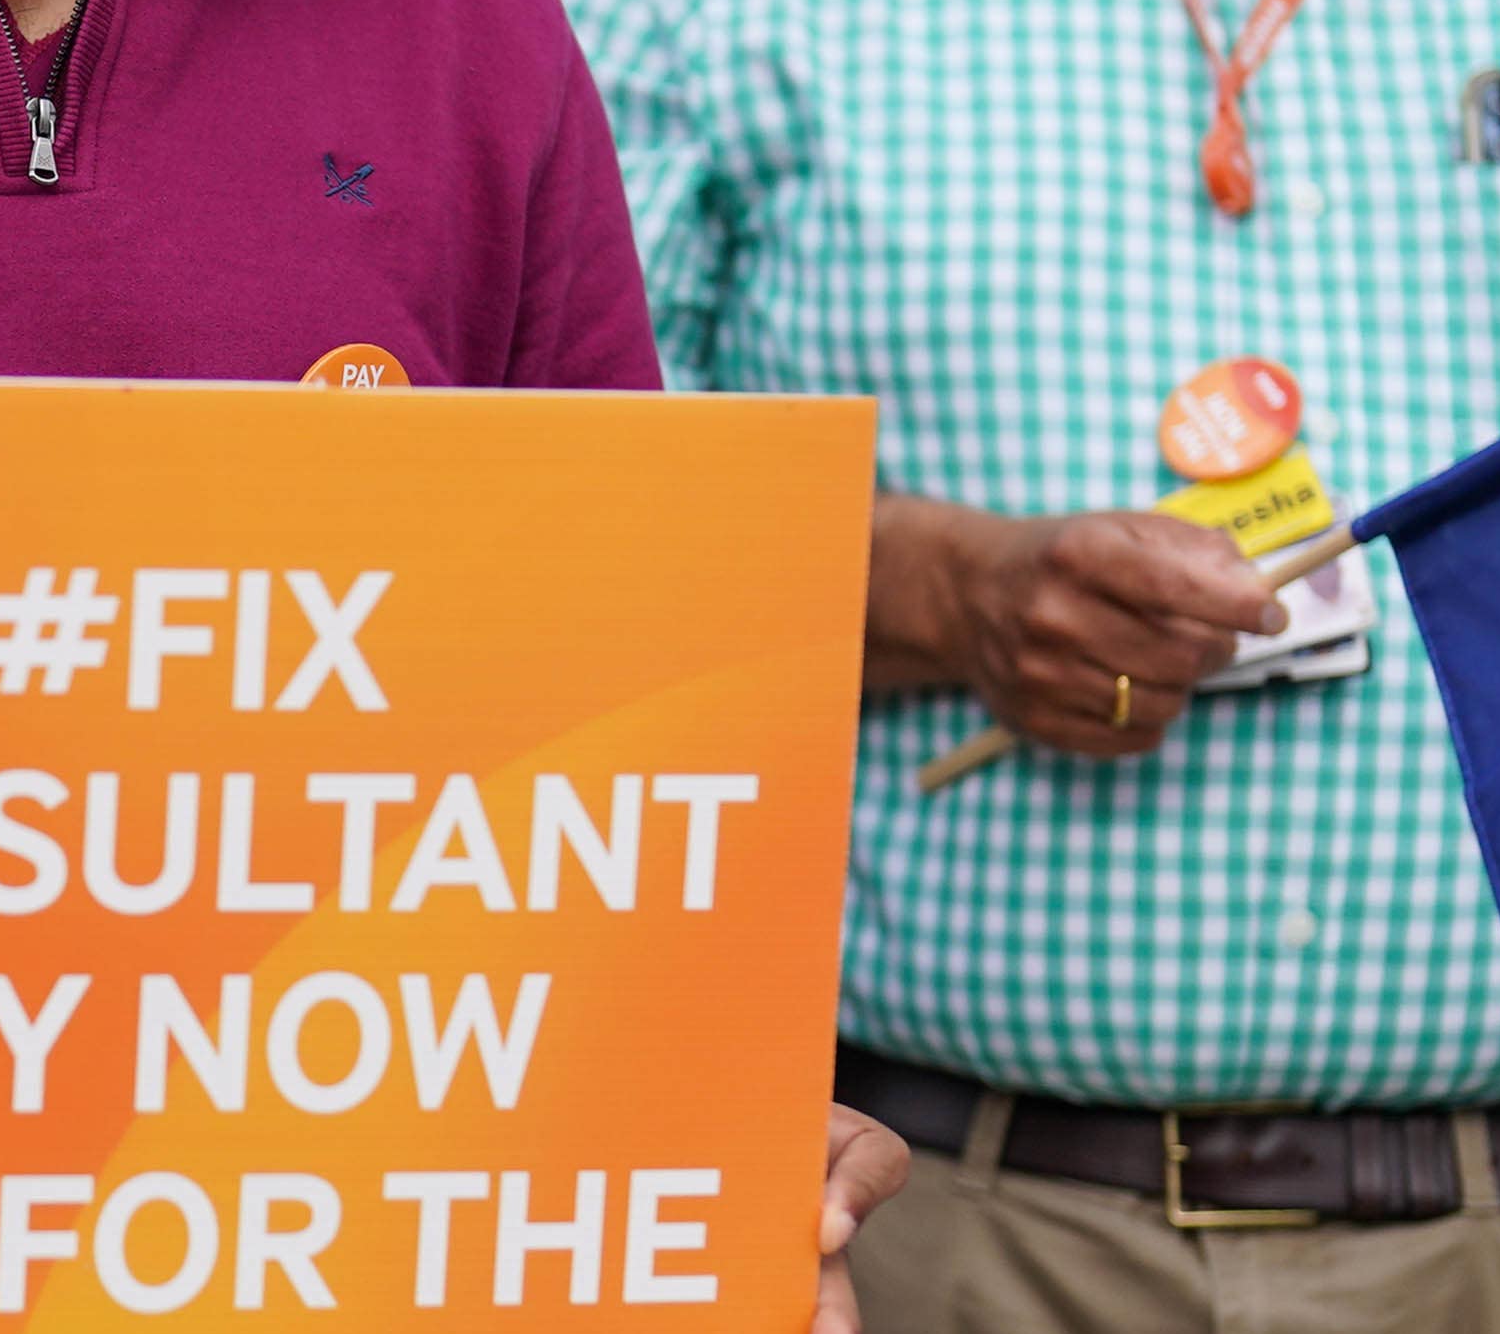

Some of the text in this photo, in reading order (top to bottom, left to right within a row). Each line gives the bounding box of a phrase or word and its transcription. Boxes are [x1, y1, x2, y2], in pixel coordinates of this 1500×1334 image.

[341, 363, 385, 389] PAY
[136, 972, 551, 1113] NOW
[384, 1169, 721, 1307] THE
